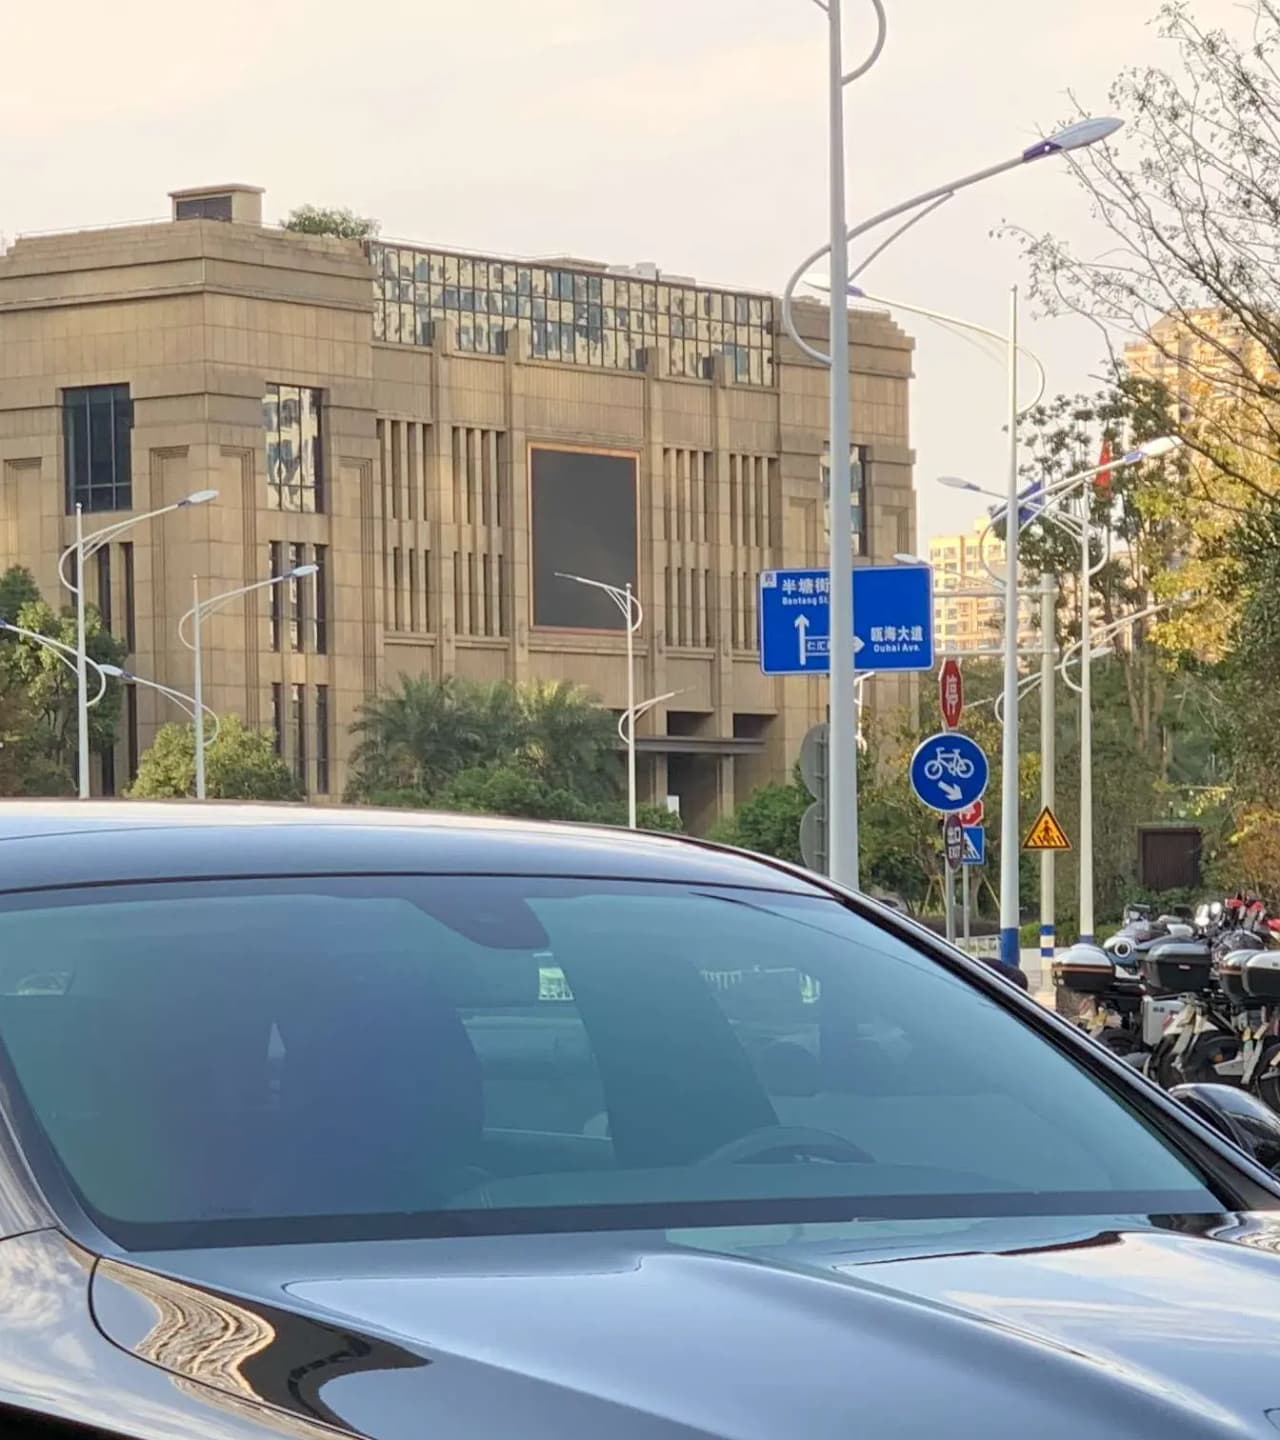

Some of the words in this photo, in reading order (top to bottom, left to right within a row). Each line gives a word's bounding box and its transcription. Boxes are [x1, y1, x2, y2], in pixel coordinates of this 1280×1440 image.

[782, 578, 830, 594] 半塘街
[871, 625, 923, 641] 瓯海大道
[807, 641, 830, 651] 仁汇
[873, 643, 900, 653] Ouhai
[945, 674, 958, 715] 停
